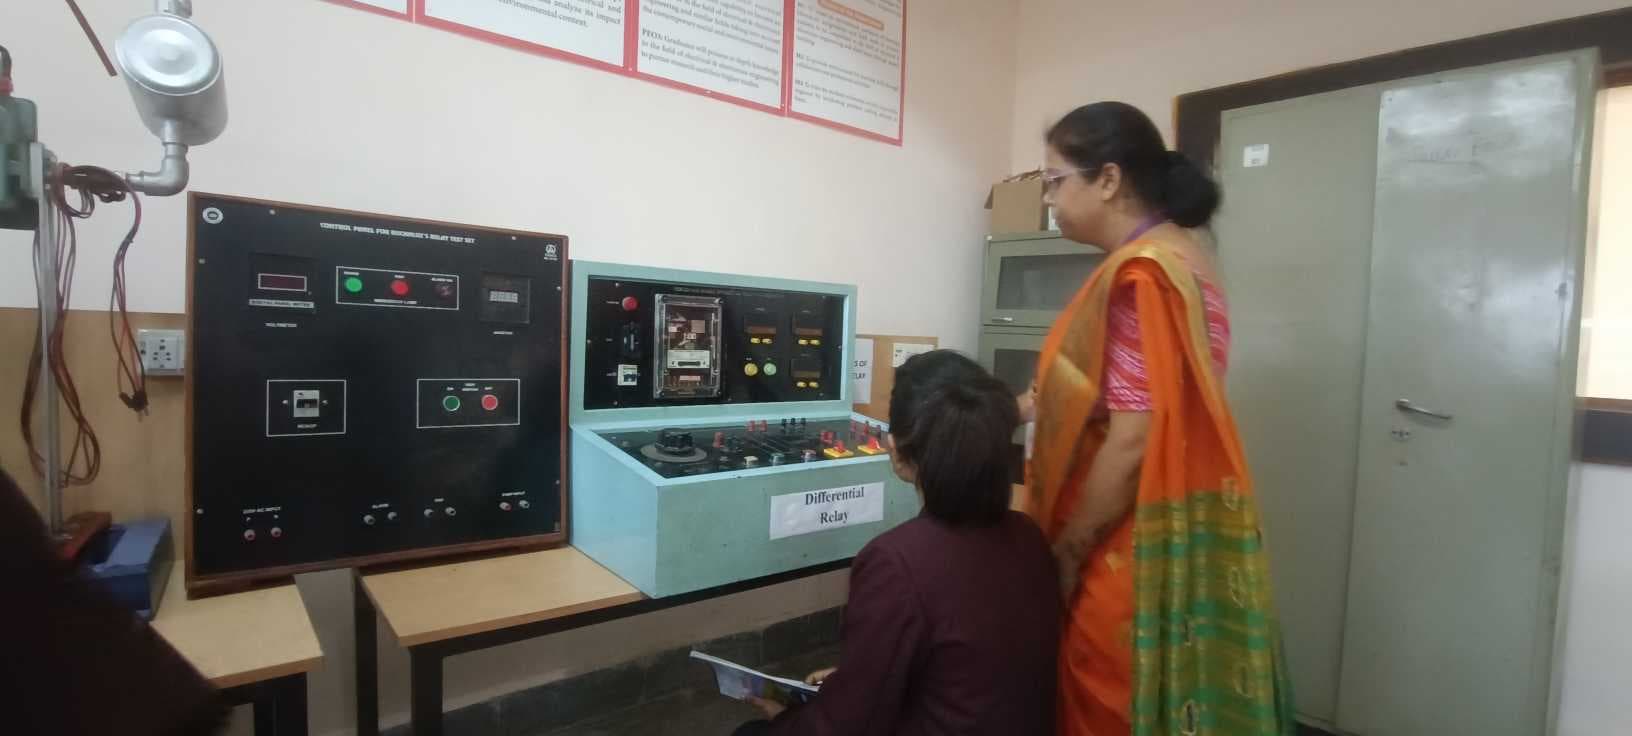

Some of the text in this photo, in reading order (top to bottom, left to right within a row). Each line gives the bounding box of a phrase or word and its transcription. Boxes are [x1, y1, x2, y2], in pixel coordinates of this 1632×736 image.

[319, 222, 352, 232] CONTROL
[353, 225, 375, 234] PANEL
[376, 228, 390, 236] FOR
[805, 486, 865, 505] Differential
[820, 511, 848, 524] Relay
